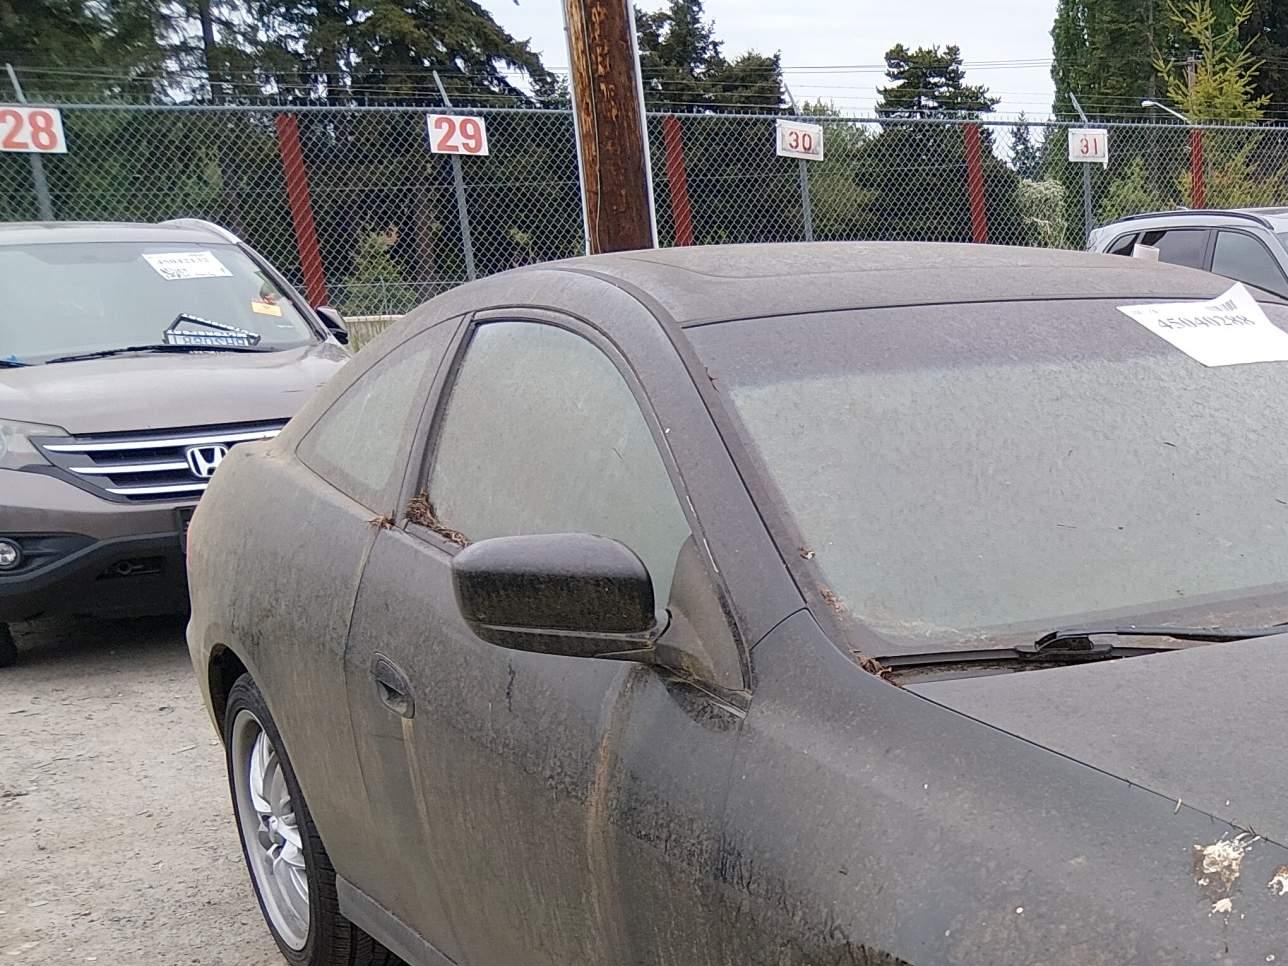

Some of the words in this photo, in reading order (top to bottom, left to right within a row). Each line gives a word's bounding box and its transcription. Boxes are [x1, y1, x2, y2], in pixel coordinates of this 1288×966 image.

[0, 109, 58, 150] 28
[434, 116, 483, 153] 29
[788, 130, 812, 151] 30
[1080, 137, 1098, 155] 31
[1157, 314, 1256, 330] 45040288
